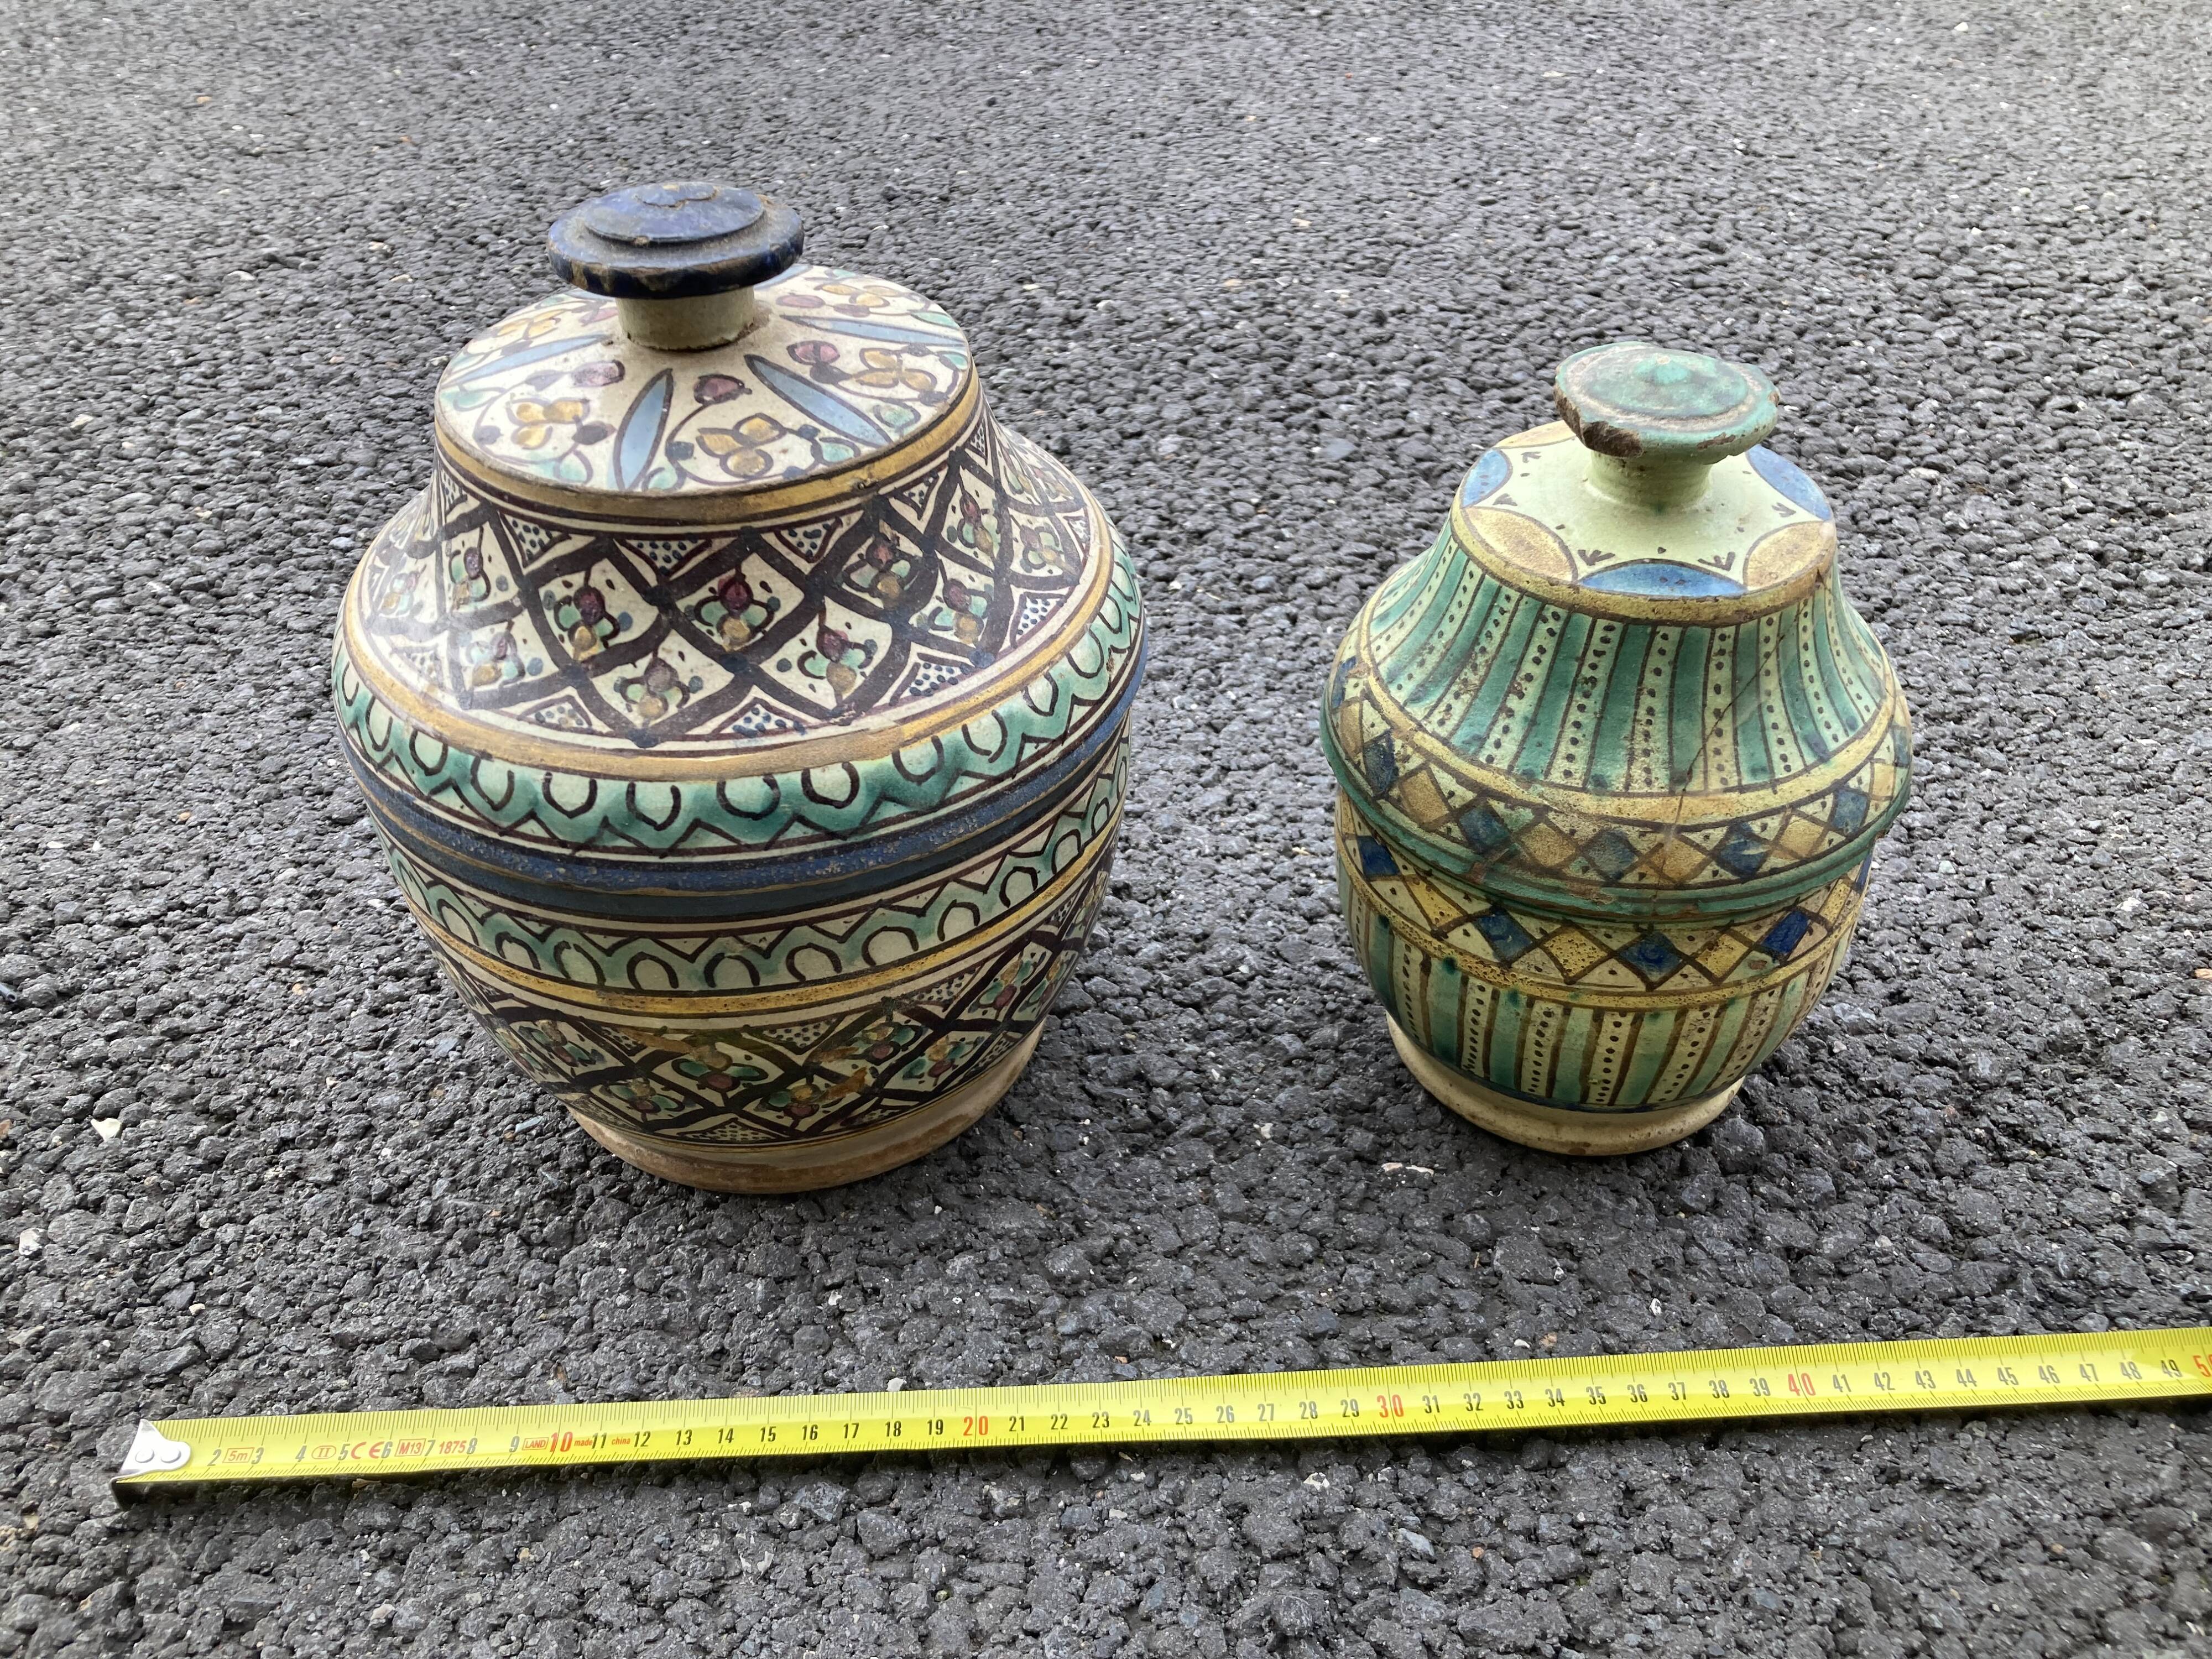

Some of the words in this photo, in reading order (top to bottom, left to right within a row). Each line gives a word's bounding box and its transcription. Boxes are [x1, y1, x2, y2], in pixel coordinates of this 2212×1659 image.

[207, 1449, 221, 1466] 2
[228, 1450, 249, 1462] 5m
[252, 1447, 264, 1465] 3
[295, 1446, 307, 1462] 4
[338, 1443, 350, 1460] 5
[381, 1441, 393, 1458] 6
[399, 1442, 421, 1454] M13
[425, 1439, 436, 1456] 7
[439, 1440, 467, 1454] 1875
[466, 1437, 478, 1454] 8
[509, 1436, 520, 1453] 9
[525, 1439, 546, 1448] LAND
[550, 1431, 573, 1452] 10
[592, 1432, 607, 1449] 11
[611, 1437, 630, 1445] china
[634, 1431, 651, 1447] 12
[676, 1429, 692, 1445] 13
[718, 1428, 734, 1444] 14
[760, 1426, 776, 1442] 15
[802, 1424, 818, 1441] 16
[843, 1422, 859, 1439] 17
[885, 1421, 901, 1437] 18
[927, 1419, 943, 1436] 19
[963, 1416, 989, 1436] 20
[1009, 1415, 1024, 1432] 21
[1051, 1413, 1068, 1430] 22
[1092, 1411, 1109, 1428] 23
[1133, 1410, 1151, 1426] 24
[1174, 1407, 1193, 1425] 25
[1216, 1405, 1235, 1423] 26
[1258, 1403, 1274, 1422] 27
[1299, 1401, 1318, 1420] 28
[1340, 1399, 1359, 1417] 29
[1376, 1394, 1404, 1418] 30
[1422, 1395, 1440, 1414] 31
[1463, 1392, 1483, 1411] 32
[1504, 1390, 1524, 1410] 33
[1545, 1388, 1565, 1407] 34
[1585, 1386, 1606, 1405] 35
[1626, 1384, 1648, 1403] 36
[1668, 1382, 1687, 1401] 37
[1709, 1380, 1730, 1399] 38
[1749, 1378, 1771, 1396] 39
[1787, 1373, 1816, 1396] 40
[1832, 1374, 1851, 1393] 41
[1874, 1371, 1895, 1391] 42
[1914, 1370, 1936, 1389] 43
[1956, 1369, 1977, 1387] 44
[1997, 1366, 2018, 1386] 45
[2038, 1365, 2060, 1384] 46
[2079, 1363, 2099, 1382] 47
[2120, 1361, 2142, 1380] 48
[2159, 1359, 2183, 1378] 49
